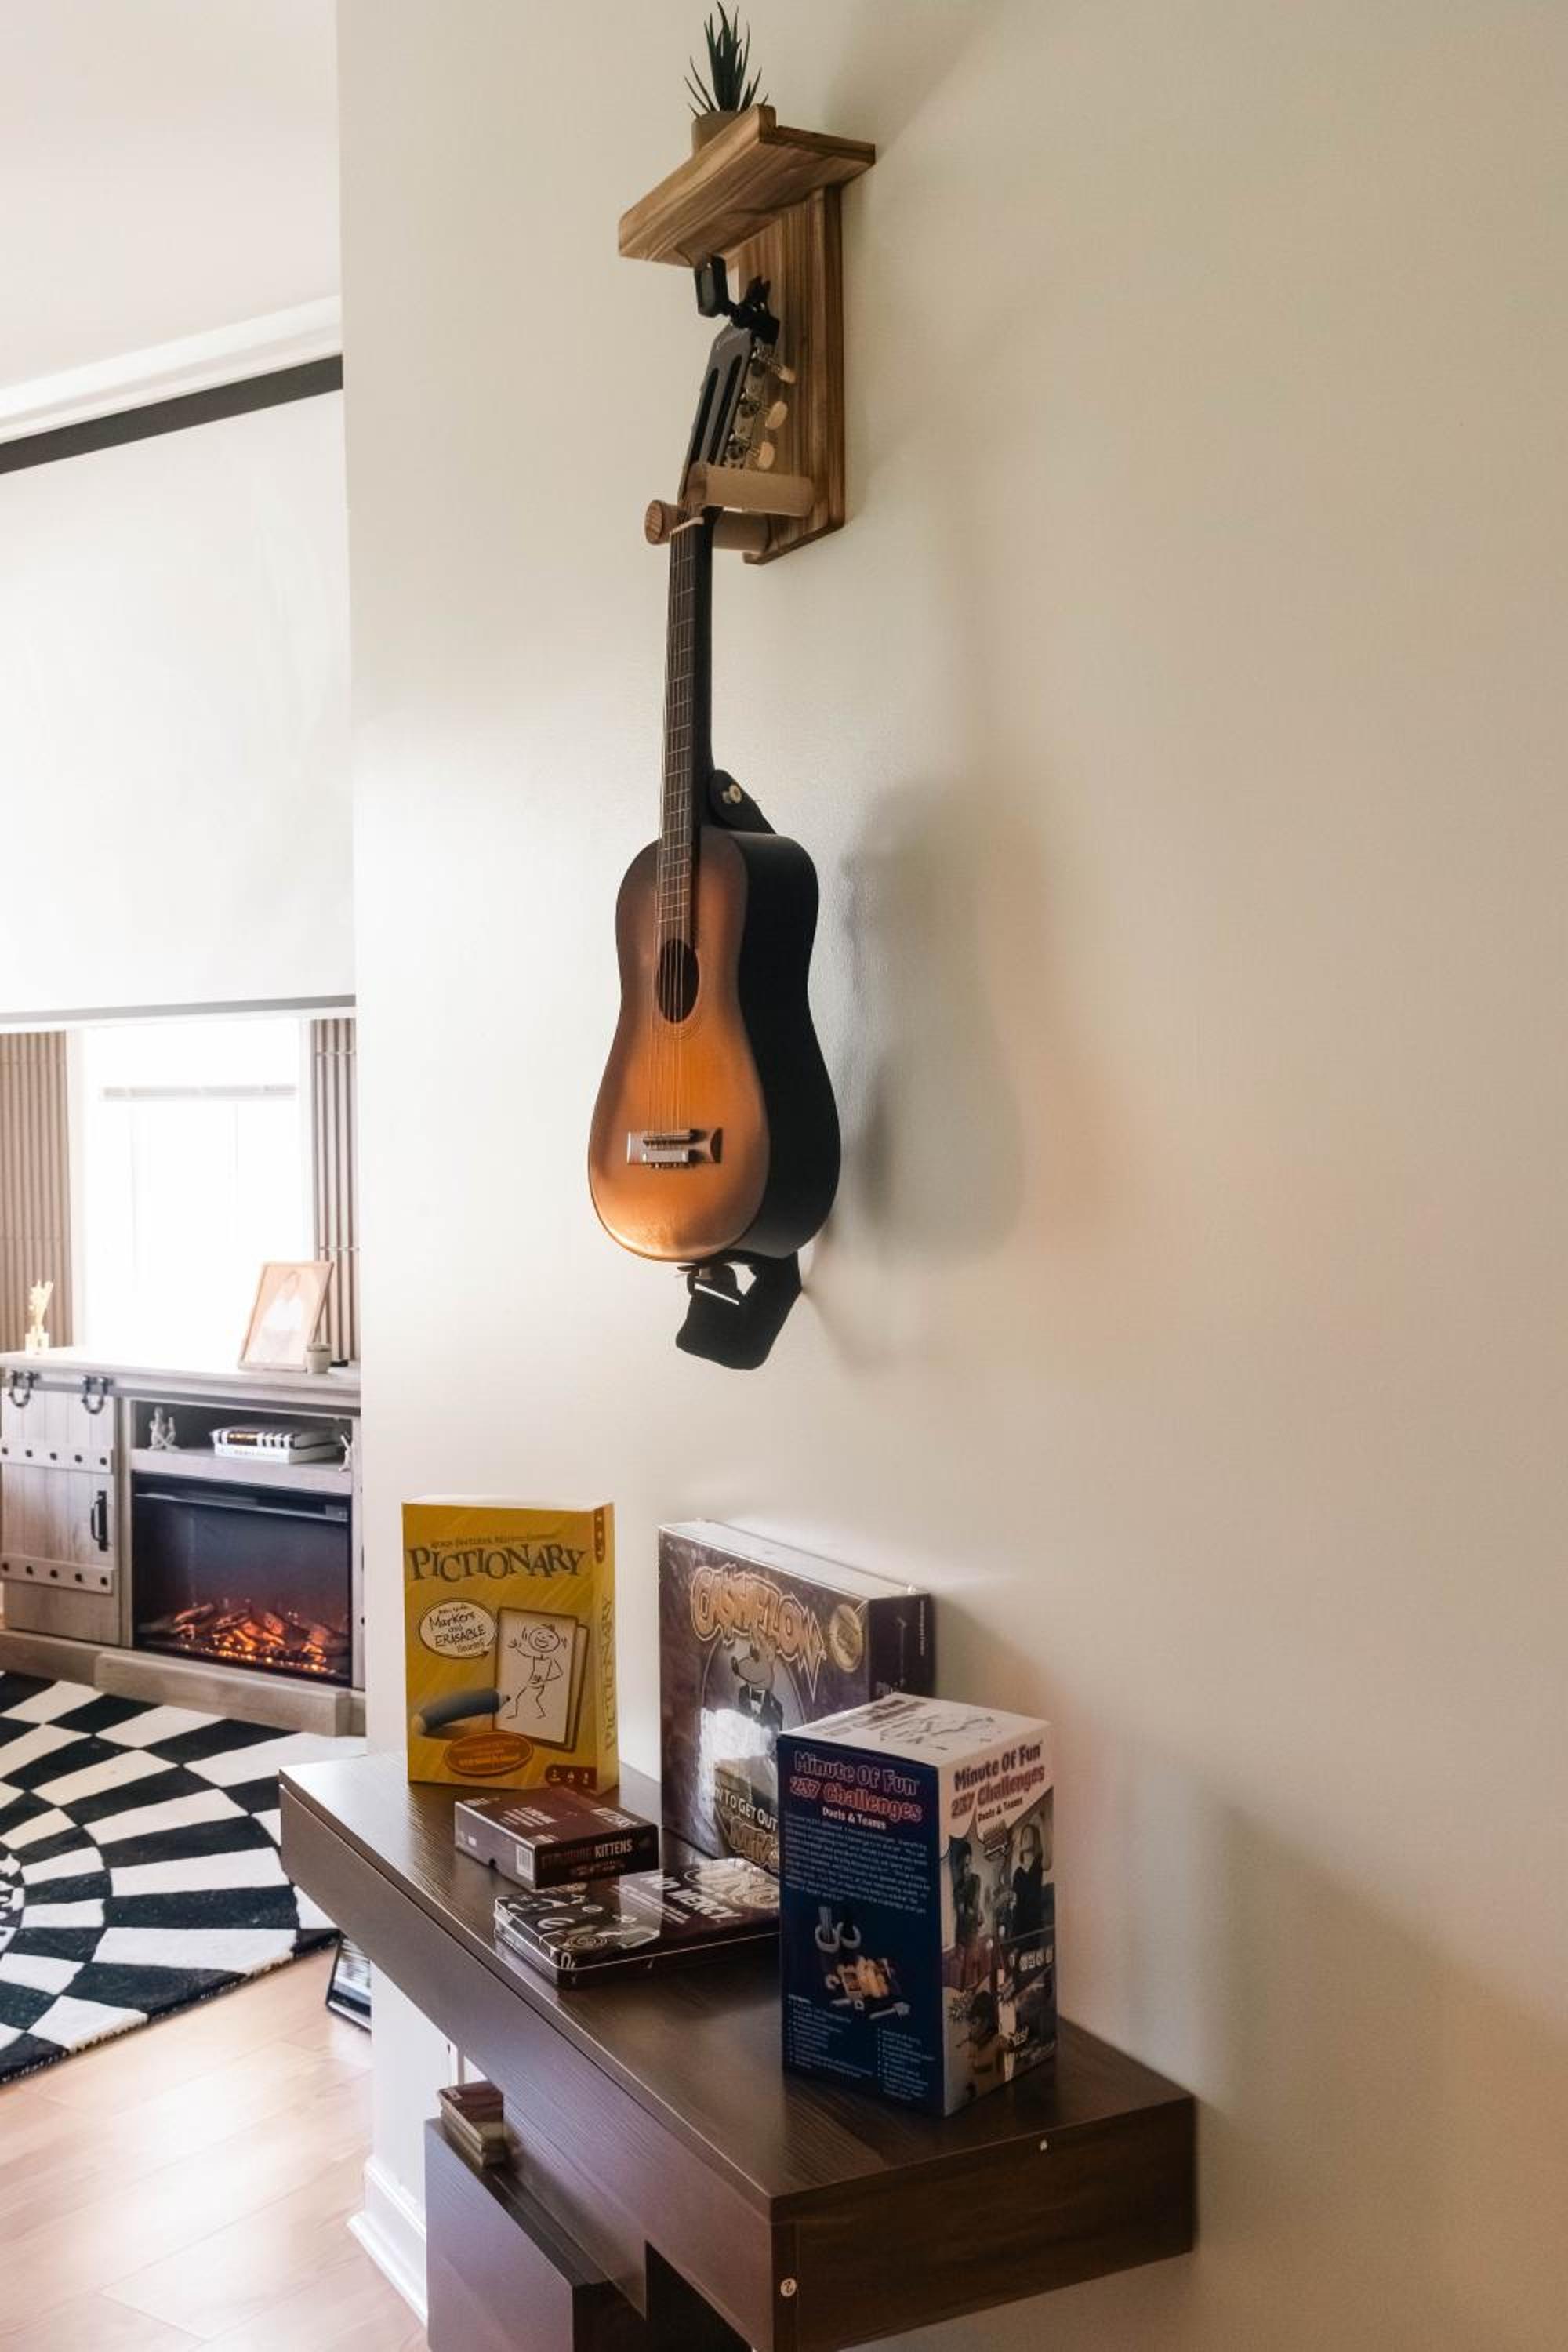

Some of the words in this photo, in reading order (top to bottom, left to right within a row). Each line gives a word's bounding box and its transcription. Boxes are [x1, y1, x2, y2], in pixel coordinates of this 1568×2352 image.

[408, 1544, 587, 1582] PICTIONARY
[429, 1611, 475, 1631] Markers
[434, 1624, 485, 1647] ERASABLE
[793, 1750, 855, 1783] Minute
[858, 1765, 880, 1788] Of
[882, 1769, 917, 1796] Fun
[953, 1759, 999, 1793] Minute
[1002, 1748, 1017, 1773] Of
[1019, 1743, 1040, 1767] Fun
[724, 1788, 737, 1809] TO
[738, 1798, 757, 1820] GET
[757, 1808, 779, 1832] OUT
[824, 1782, 923, 1823] Challenges
[950, 1791, 975, 1819] 237
[977, 1764, 1045, 1807] Challenges
[822, 1806, 846, 1822] Duels
[847, 1810, 855, 1824] &
[857, 1813, 887, 1831] Teams
[594, 1838, 633, 1858] KITTENS
[640, 1875, 681, 1890] NO
[666, 1889, 742, 1919] MERCY
